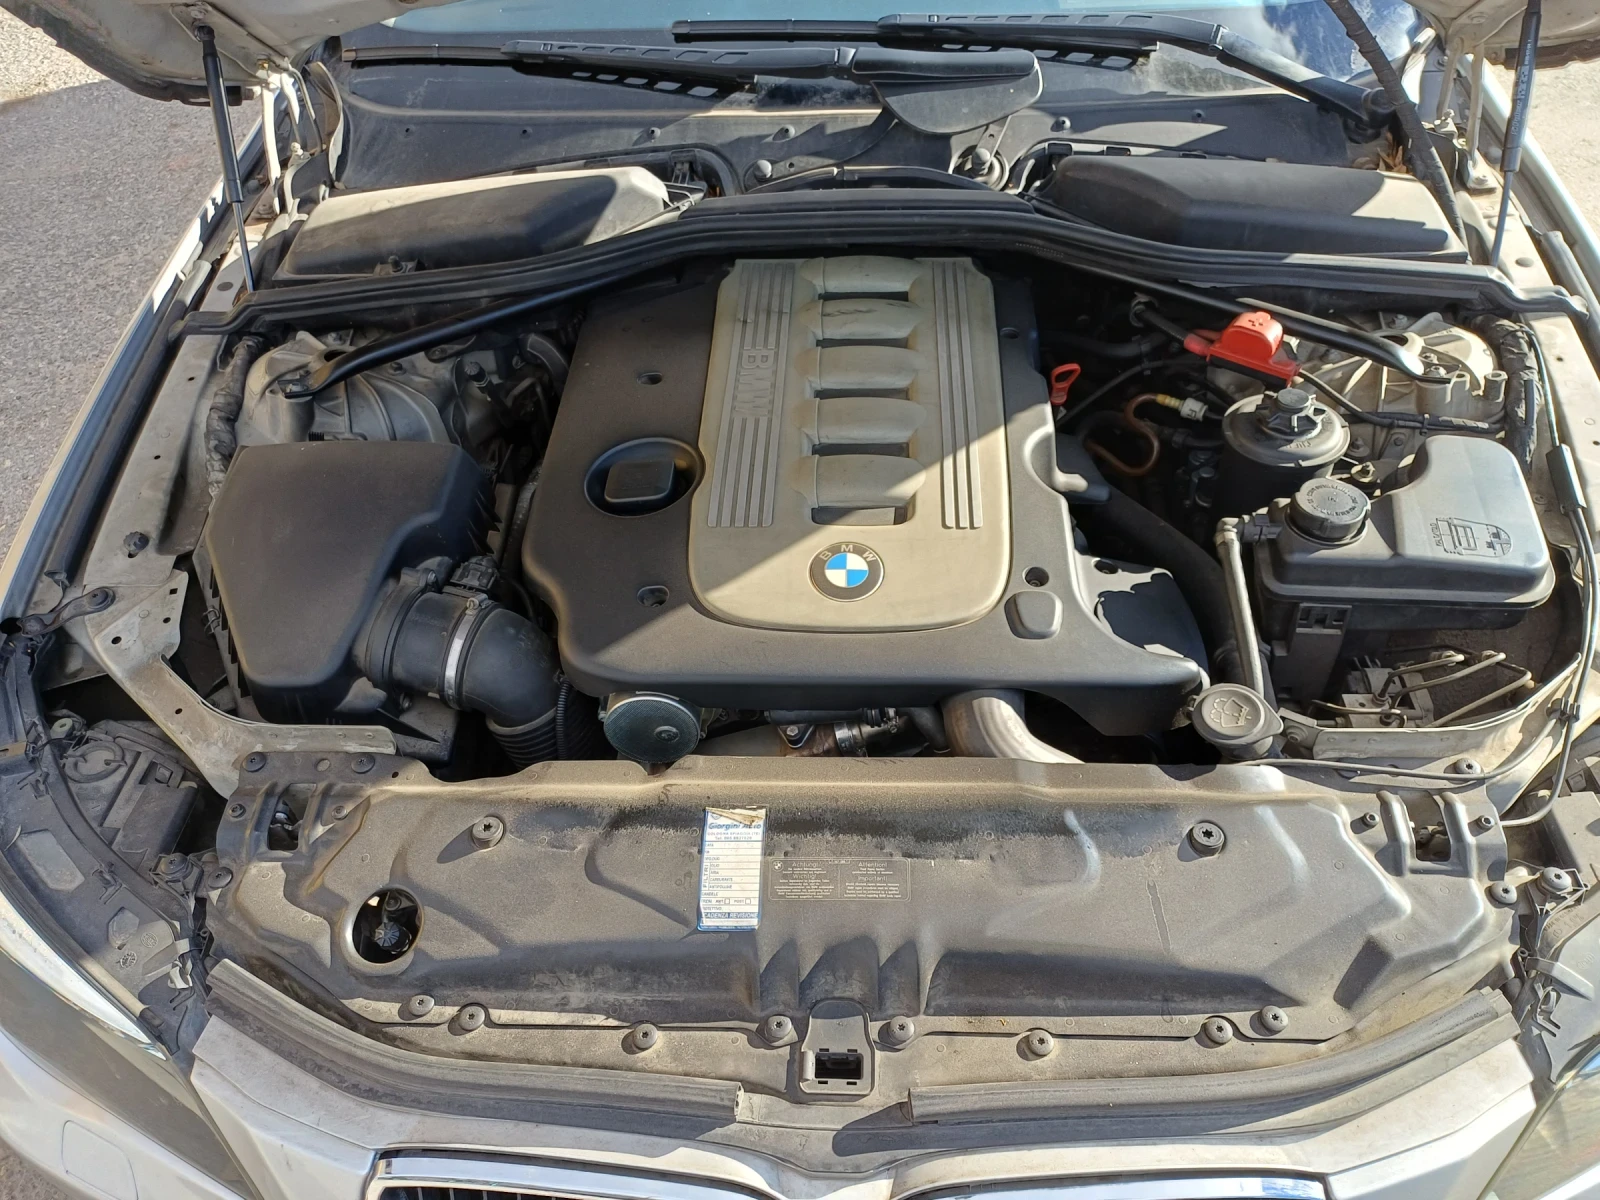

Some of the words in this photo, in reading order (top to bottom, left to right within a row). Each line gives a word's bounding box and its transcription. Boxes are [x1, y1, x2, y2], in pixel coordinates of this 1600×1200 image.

[734, 349, 775, 417] BMW
[819, 544, 877, 562] BMW
[708, 822, 741, 830] Giorgini
